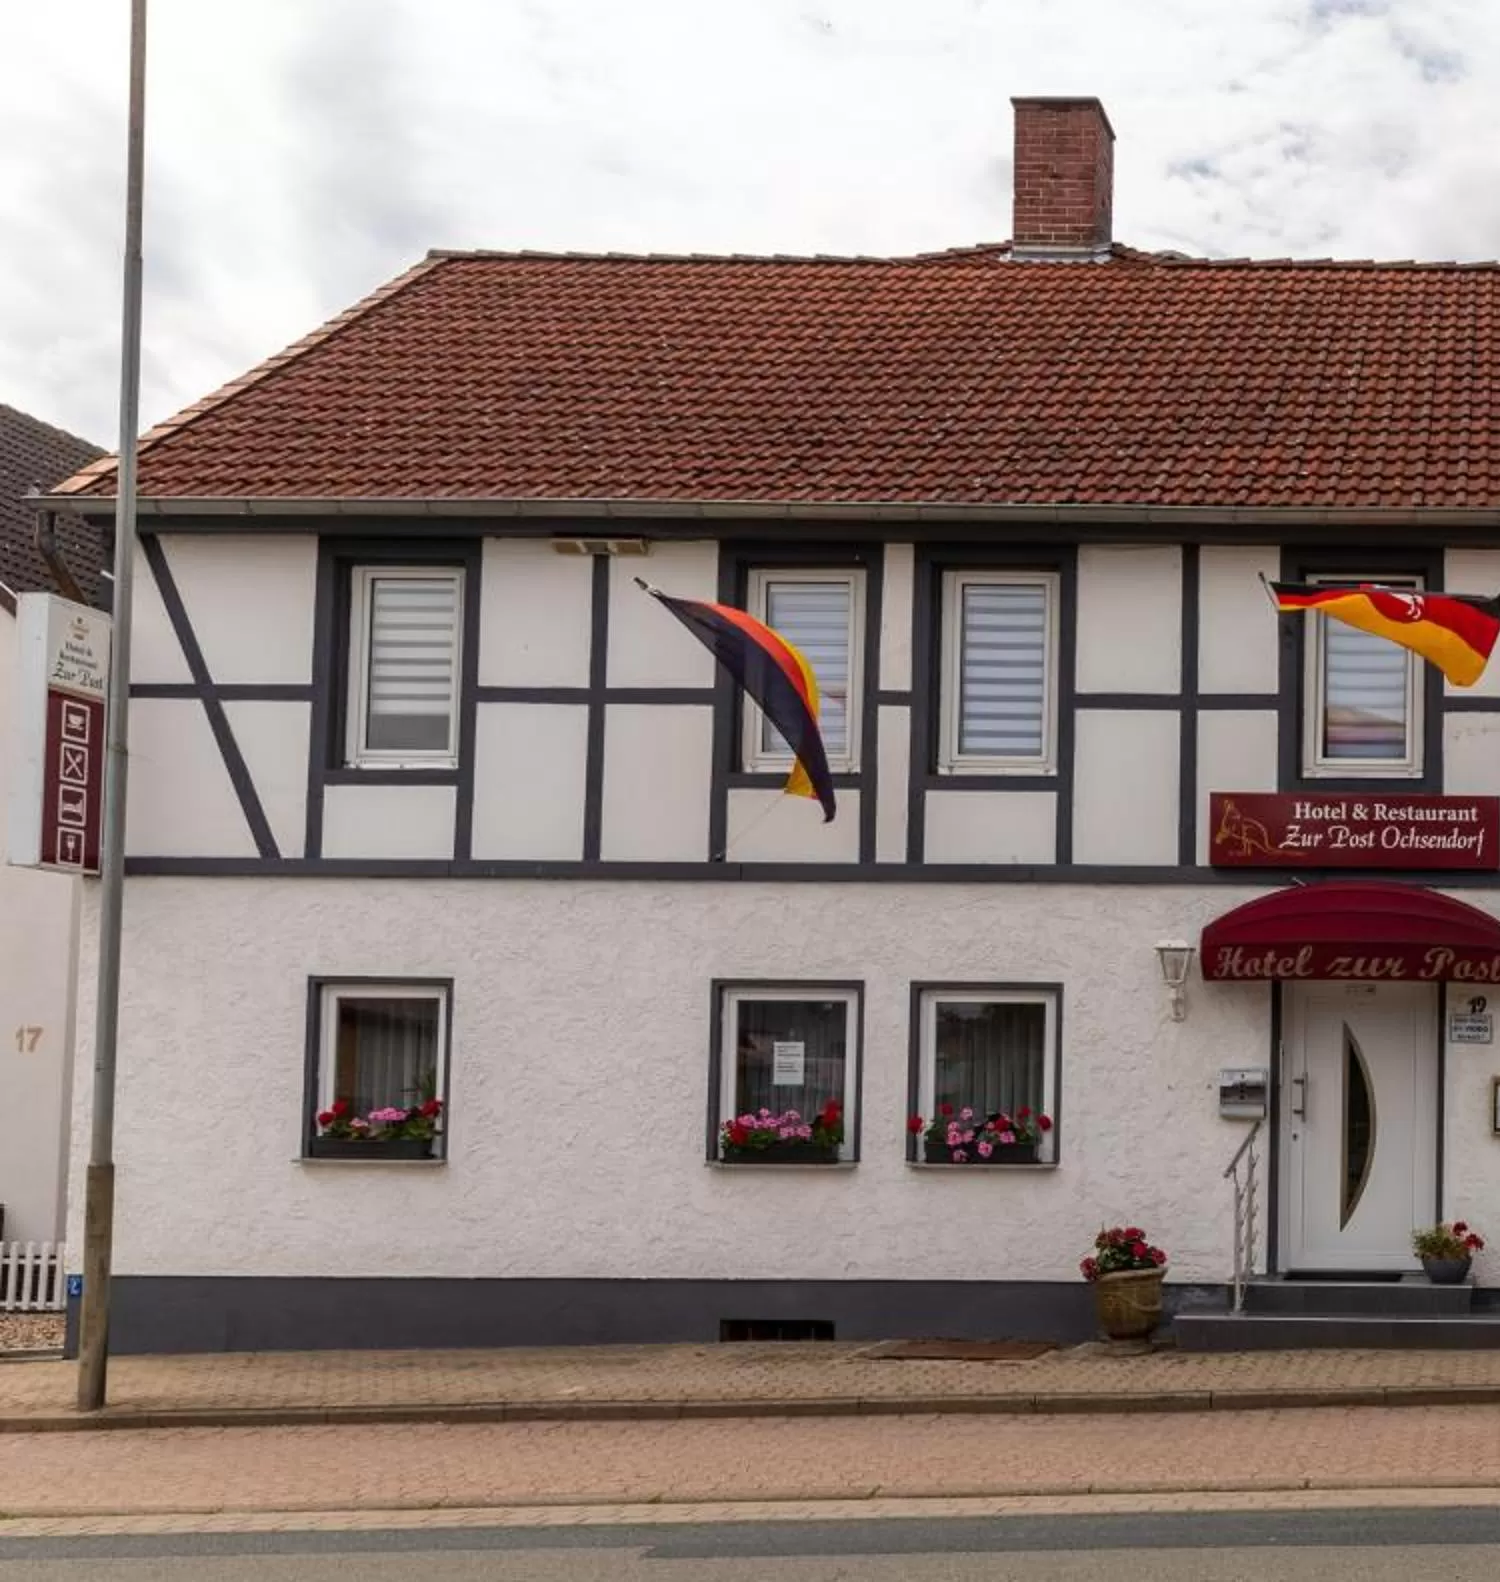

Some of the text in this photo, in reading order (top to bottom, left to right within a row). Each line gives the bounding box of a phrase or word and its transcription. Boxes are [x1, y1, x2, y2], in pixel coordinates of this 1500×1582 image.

[1295, 803, 1478, 822] Hotel & Restaurant
[1279, 825, 1485, 856] Zur Post Ochsendorf
[1213, 945, 1500, 981] Hotel zur Post
[15, 1026, 43, 1053] 17
